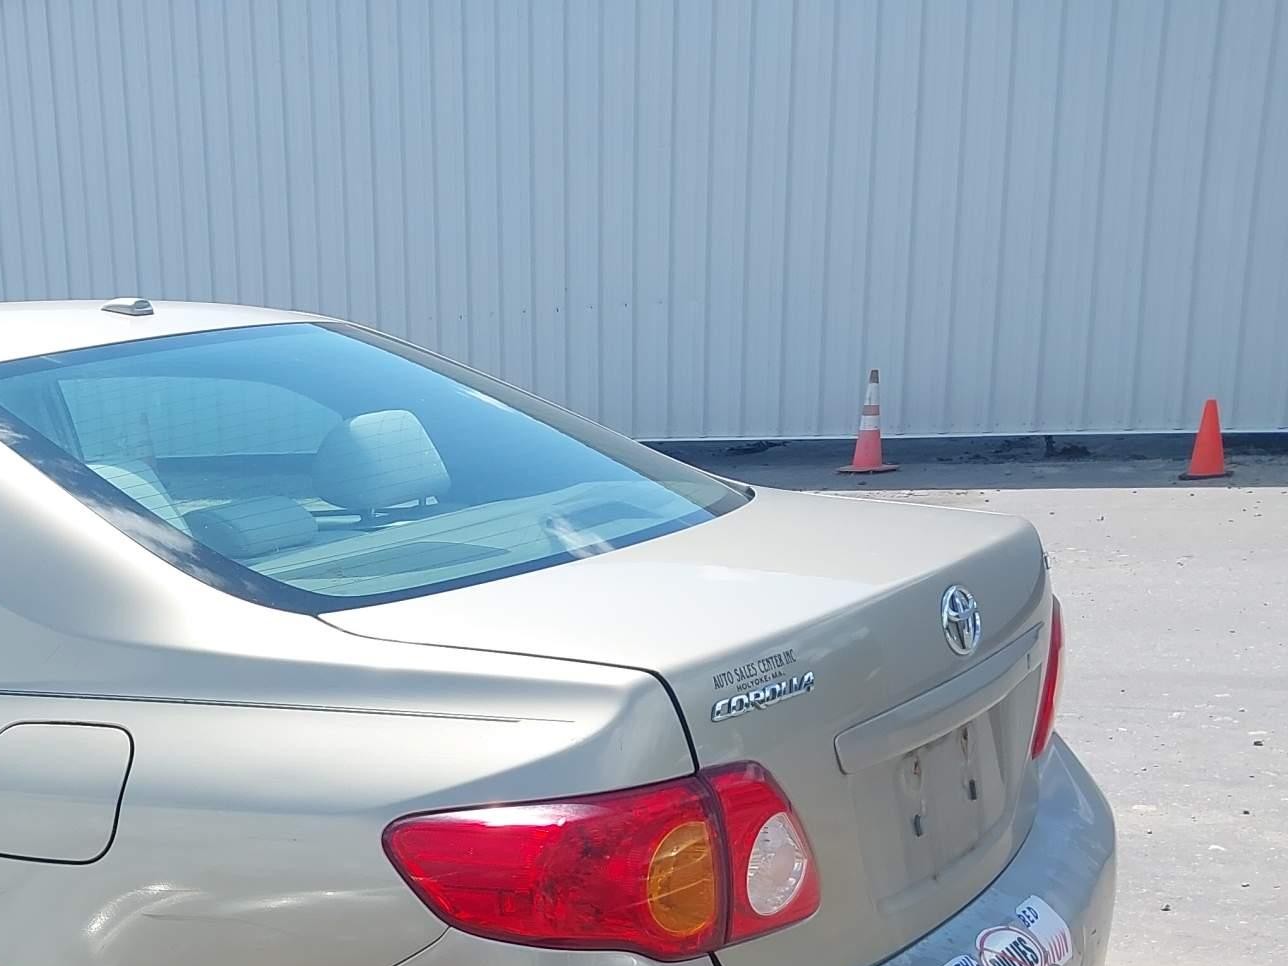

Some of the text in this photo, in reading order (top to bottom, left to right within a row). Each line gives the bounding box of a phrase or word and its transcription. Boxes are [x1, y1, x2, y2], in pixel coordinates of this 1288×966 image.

[713, 648, 797, 690] AUTO SALES CENTER INC
[711, 671, 814, 723] COROLLA
